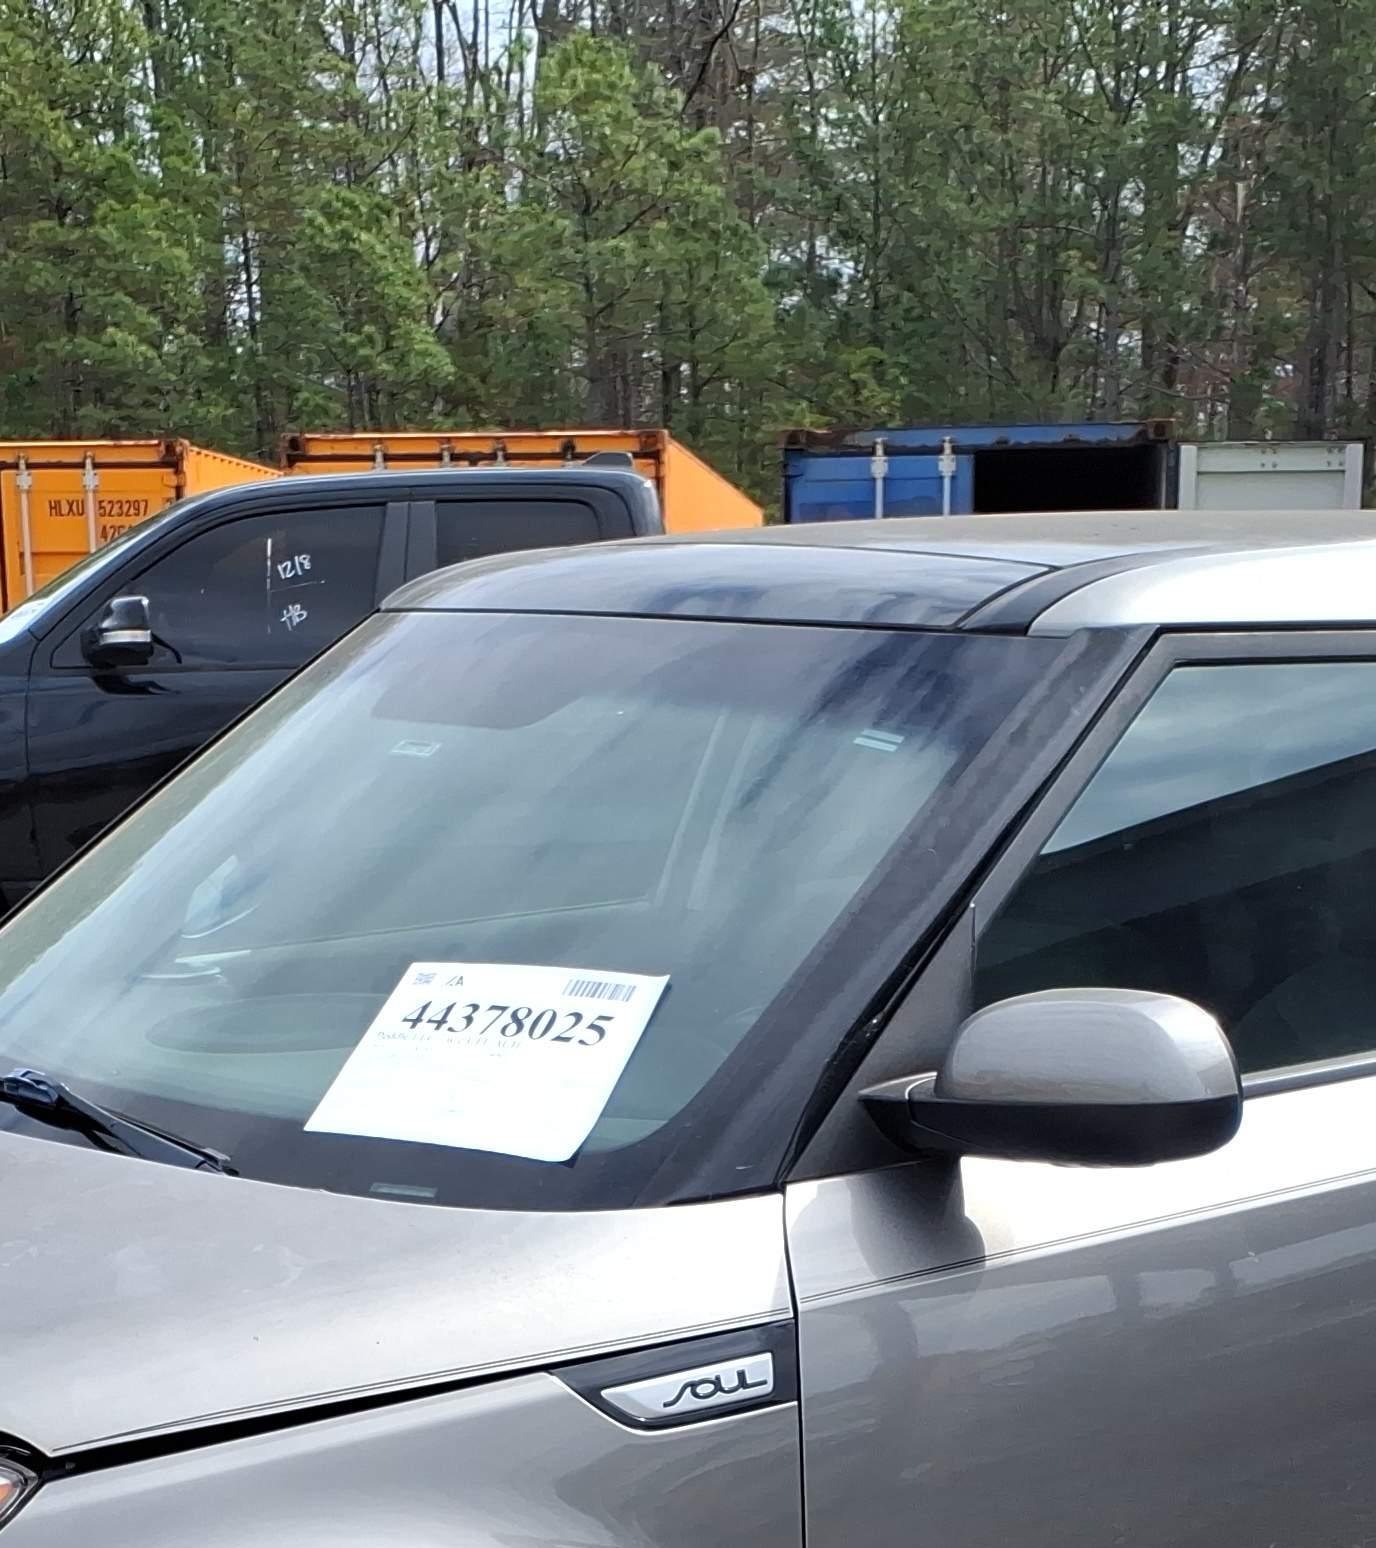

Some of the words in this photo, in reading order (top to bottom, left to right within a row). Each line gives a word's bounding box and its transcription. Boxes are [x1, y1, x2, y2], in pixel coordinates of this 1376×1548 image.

[48, 499, 85, 517] HLXU
[98, 499, 149, 517] 523297
[400, 1000, 617, 1047] 44378025
